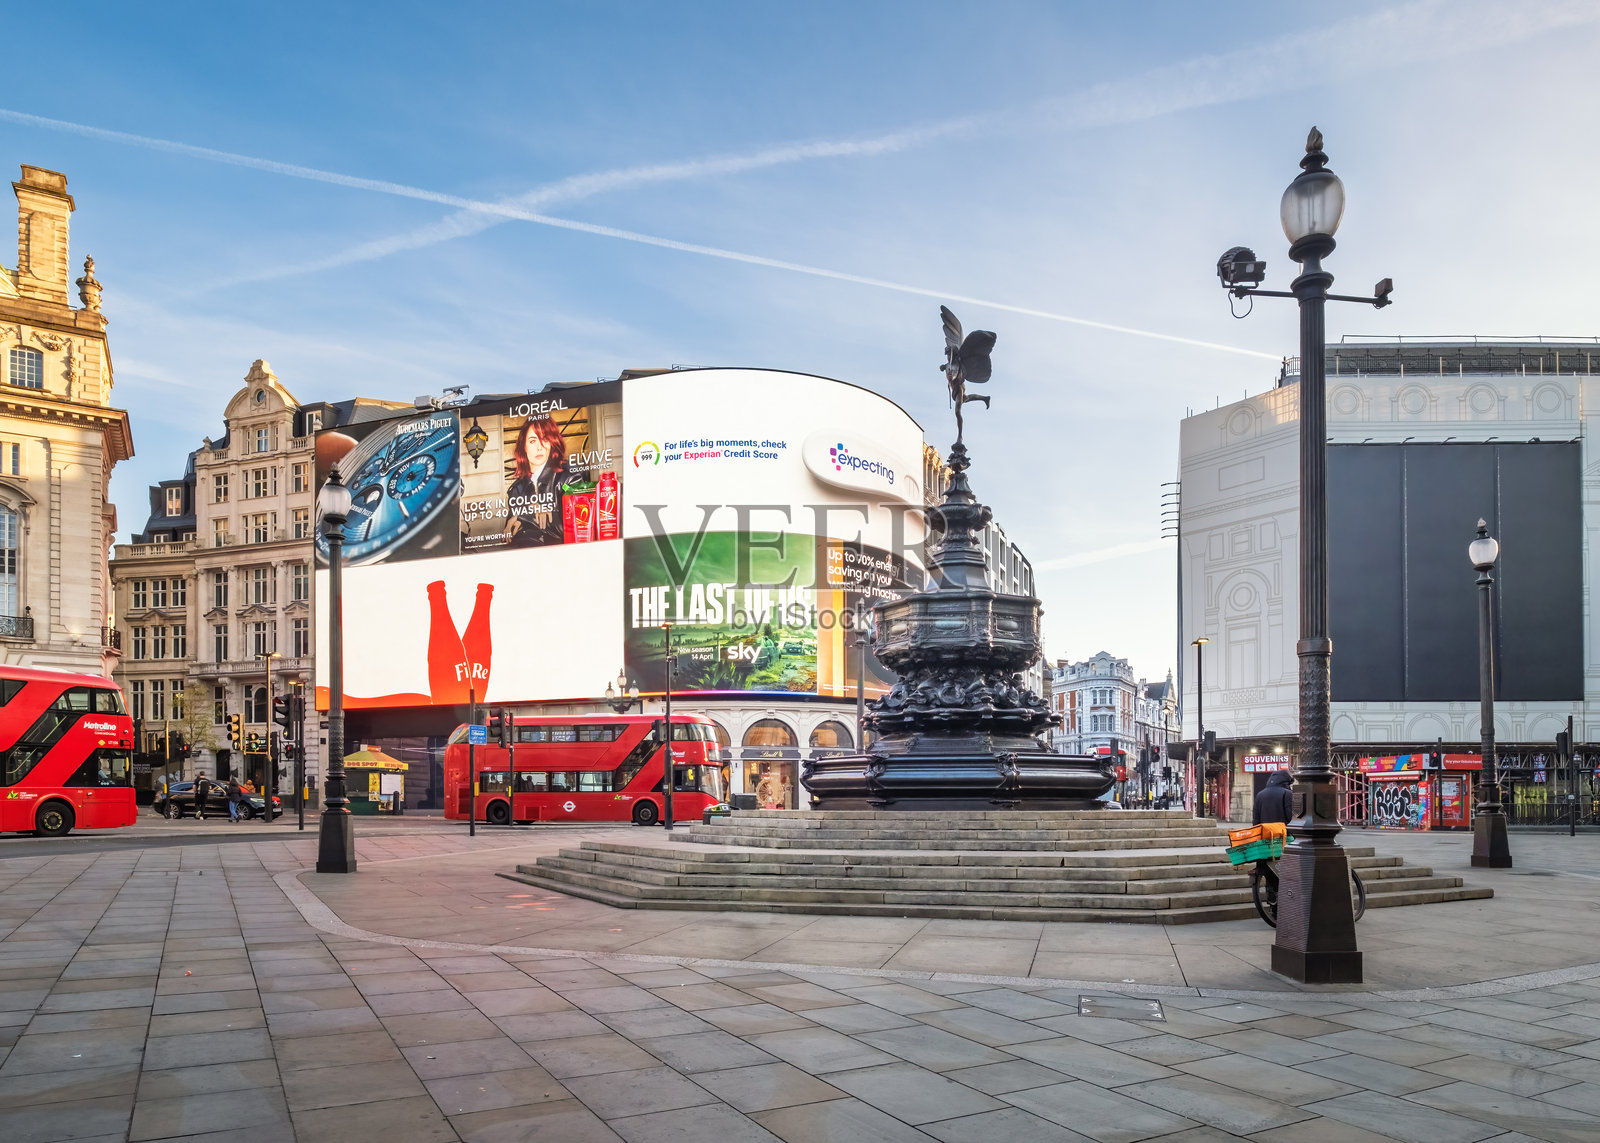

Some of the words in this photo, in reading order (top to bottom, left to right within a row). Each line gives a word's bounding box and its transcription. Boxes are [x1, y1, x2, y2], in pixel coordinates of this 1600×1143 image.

[509, 398, 568, 418] L'ORÉAL
[430, 418, 452, 430] PIGUET
[664, 442, 677, 450] For
[680, 440, 698, 448] life's
[700, 438, 714, 448] big
[716, 439, 760, 448] moments,
[761, 440, 787, 449] check
[568, 448, 613, 466] ELVIVE
[664, 453, 682, 464] your
[724, 450, 750, 458] Credit
[753, 450, 778, 459] Score
[398, 462, 410, 474] NOV
[590, 462, 612, 470] PROTECT
[838, 453, 894, 484] expecting
[411, 482, 426, 495] MAY
[464, 500, 492, 512] LOCK
[496, 498, 506, 508] IN
[508, 492, 554, 506] COLOUR
[464, 513, 478, 522] UP
[480, 511, 492, 520] TO
[496, 509, 508, 518] 40
[828, 549, 842, 564] Up
[844, 552, 856, 562] to
[856, 554, 874, 567] 70%
[876, 560, 900, 578] energy
[828, 566, 862, 581] saving
[864, 572, 875, 582] on
[876, 574, 892, 586] your
[828, 580, 870, 598] washing
[630, 586, 670, 628] THE
[675, 582, 737, 624] LAST
[699, 653, 714, 661] April
[727, 642, 762, 664] sky
[84, 721, 116, 730] Metroline
